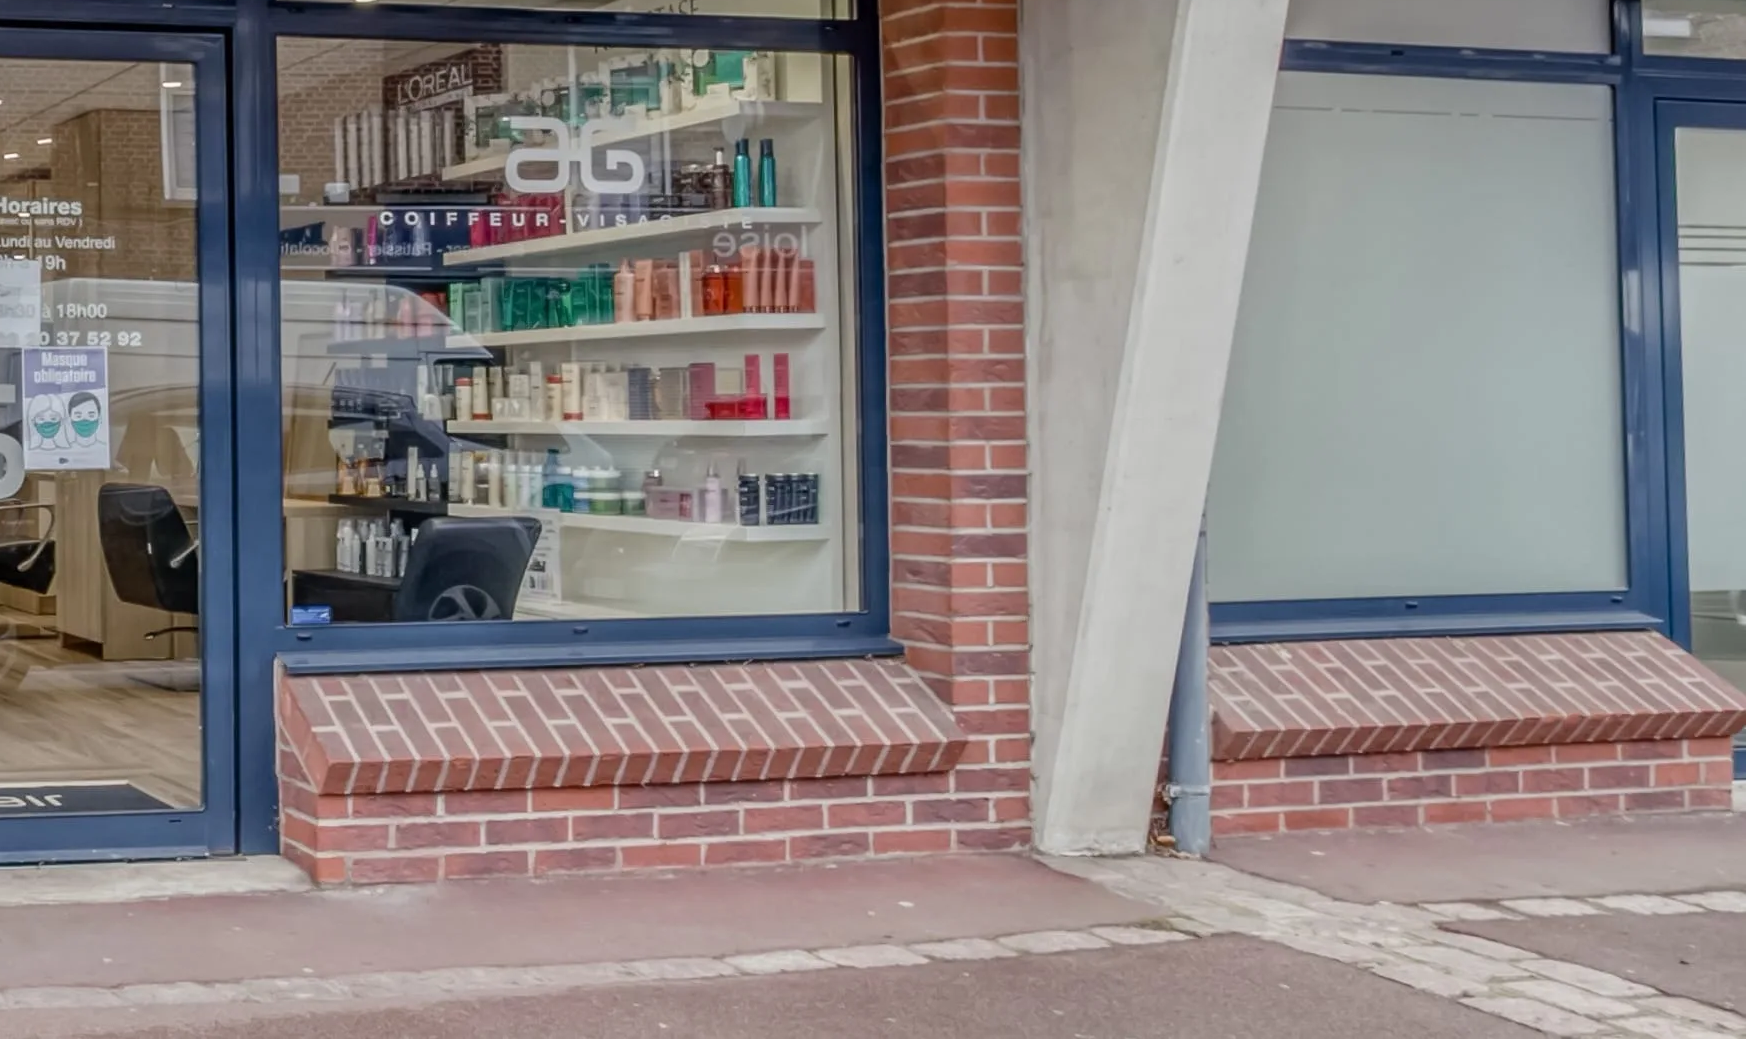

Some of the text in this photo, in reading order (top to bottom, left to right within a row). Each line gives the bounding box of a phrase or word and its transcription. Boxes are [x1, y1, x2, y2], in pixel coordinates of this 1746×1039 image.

[34, 237, 52, 249] au
[55, 235, 116, 250] Vendredi
[56, 304, 108, 319] 18h00
[56, 331, 80, 347] 37
[86, 331, 112, 347] 52
[117, 331, 143, 347] 92
[40, 351, 88, 369] Masque
[33, 367, 97, 385] obligatoire
